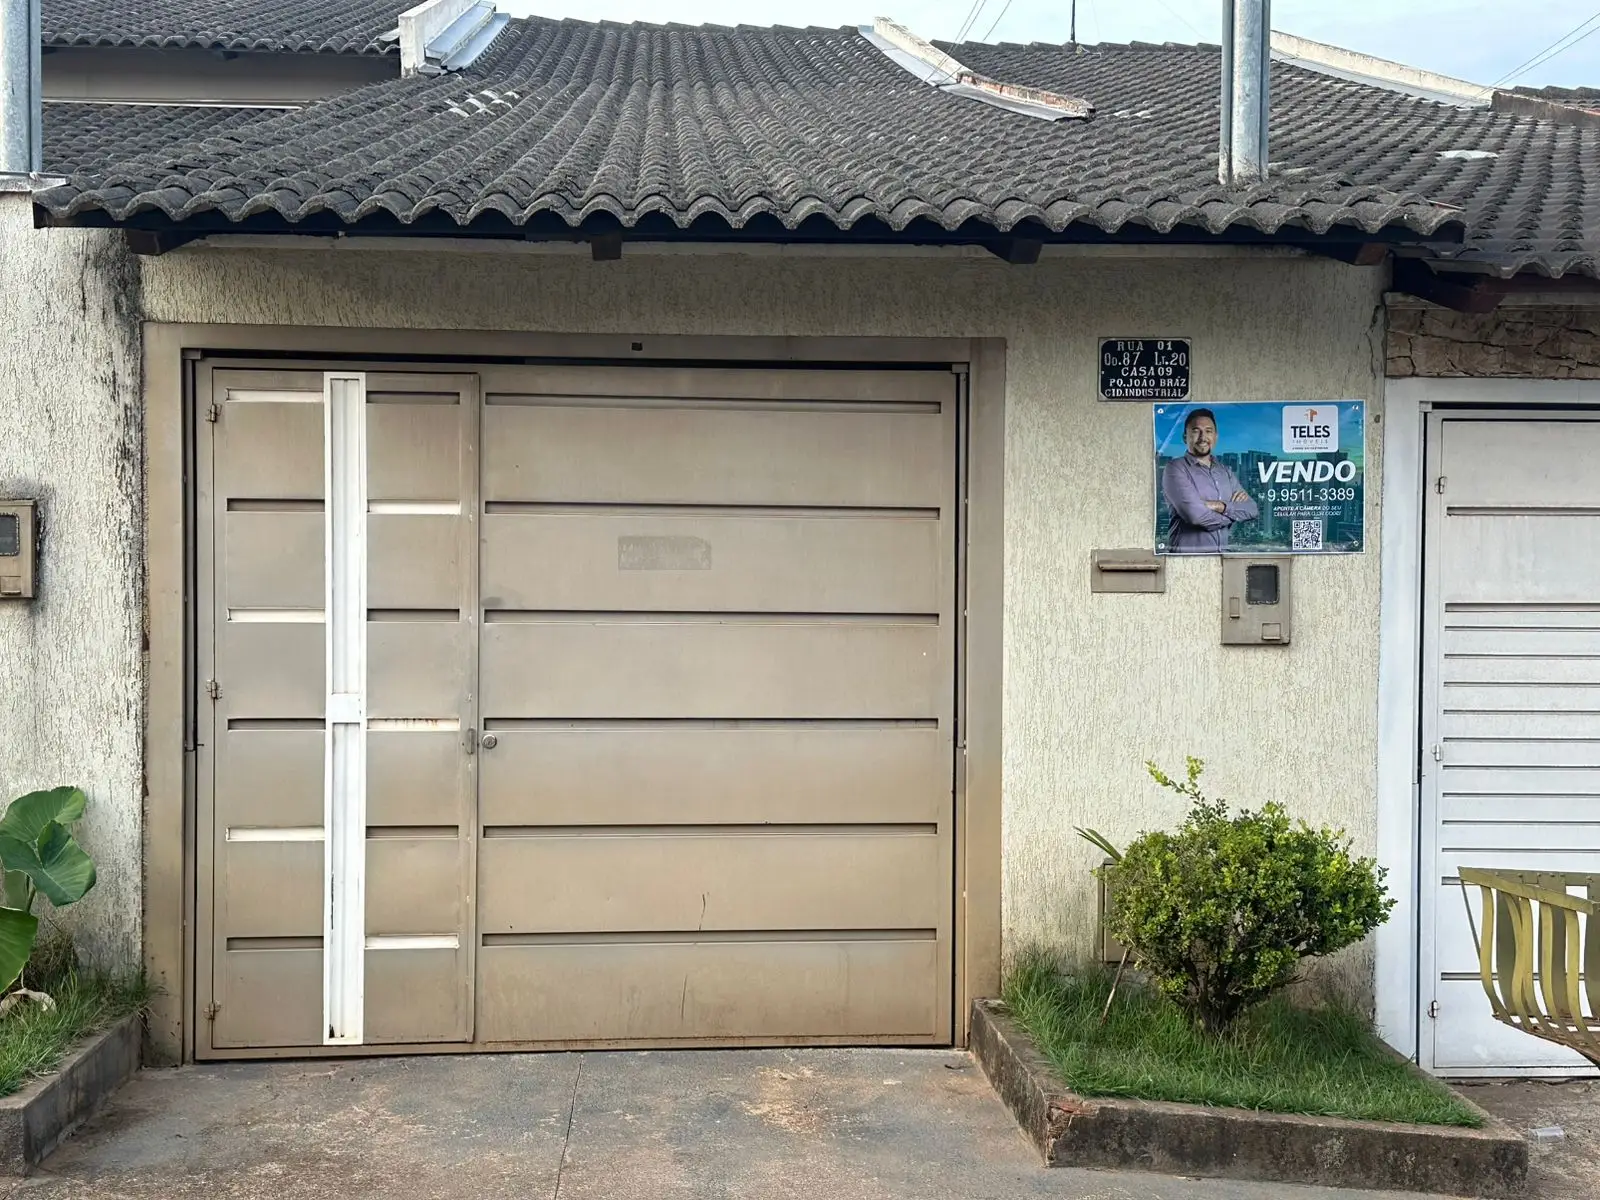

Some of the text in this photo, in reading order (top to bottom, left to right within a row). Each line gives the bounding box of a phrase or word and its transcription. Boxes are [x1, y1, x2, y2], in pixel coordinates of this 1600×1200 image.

[1117, 341, 1173, 351] RUA 01
[1121, 366, 1173, 376] CASA 09
[1290, 425, 1331, 438] TELES
[1257, 460, 1356, 483] VENDO
[1267, 487, 1355, 502] 9.9511-3389
